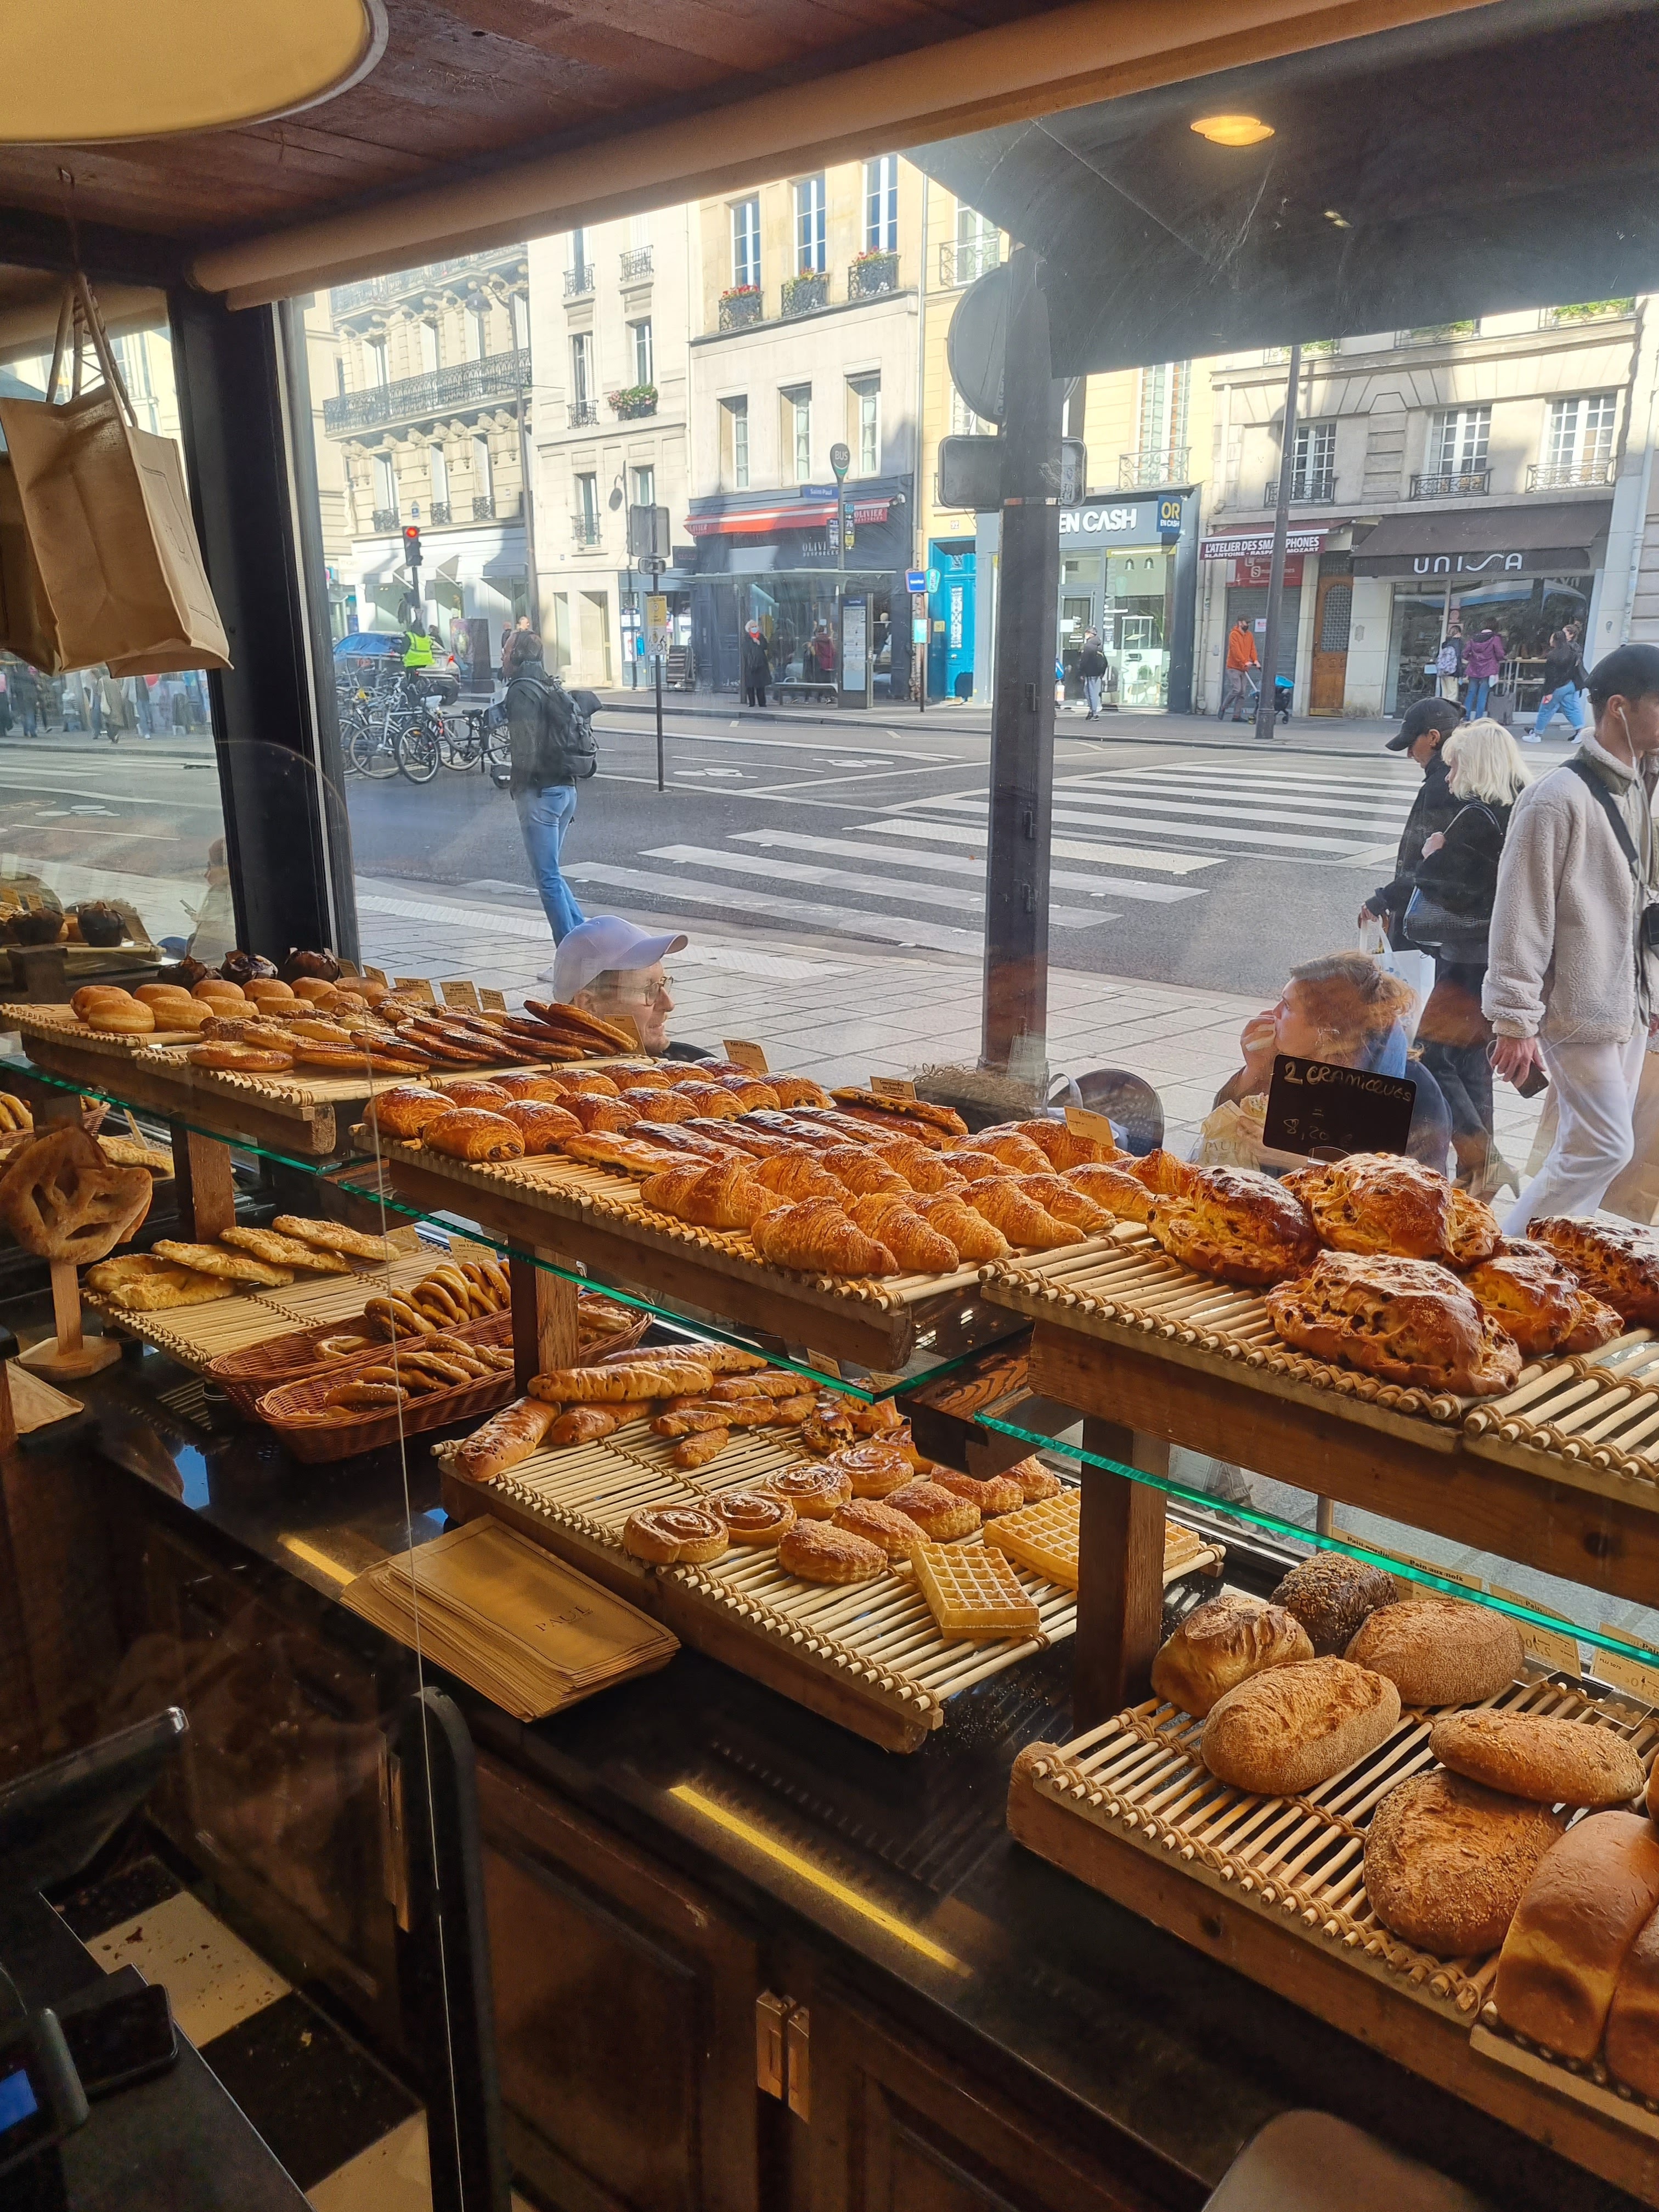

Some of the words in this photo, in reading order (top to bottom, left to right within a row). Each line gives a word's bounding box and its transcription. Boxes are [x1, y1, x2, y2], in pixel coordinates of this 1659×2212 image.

[834, 450, 848, 461] BUS
[854, 508, 883, 518] OLIVIER
[1059, 512, 1080, 534] EN
[1082, 508, 1137, 533] CASH
[1161, 501, 1180, 520] OR
[1205, 541, 1240, 554] L'ATELIER
[1241, 540, 1257, 551] DES
[1413, 552, 1523, 574] UNISA
[1284, 1061, 1304, 1085] 2
[1410, 1559, 1428, 1571] Pain
[1429, 1567, 1443, 1576] aux
[1444, 1570, 1464, 1582] noix
[535, 1606, 590, 1632] PAUL
